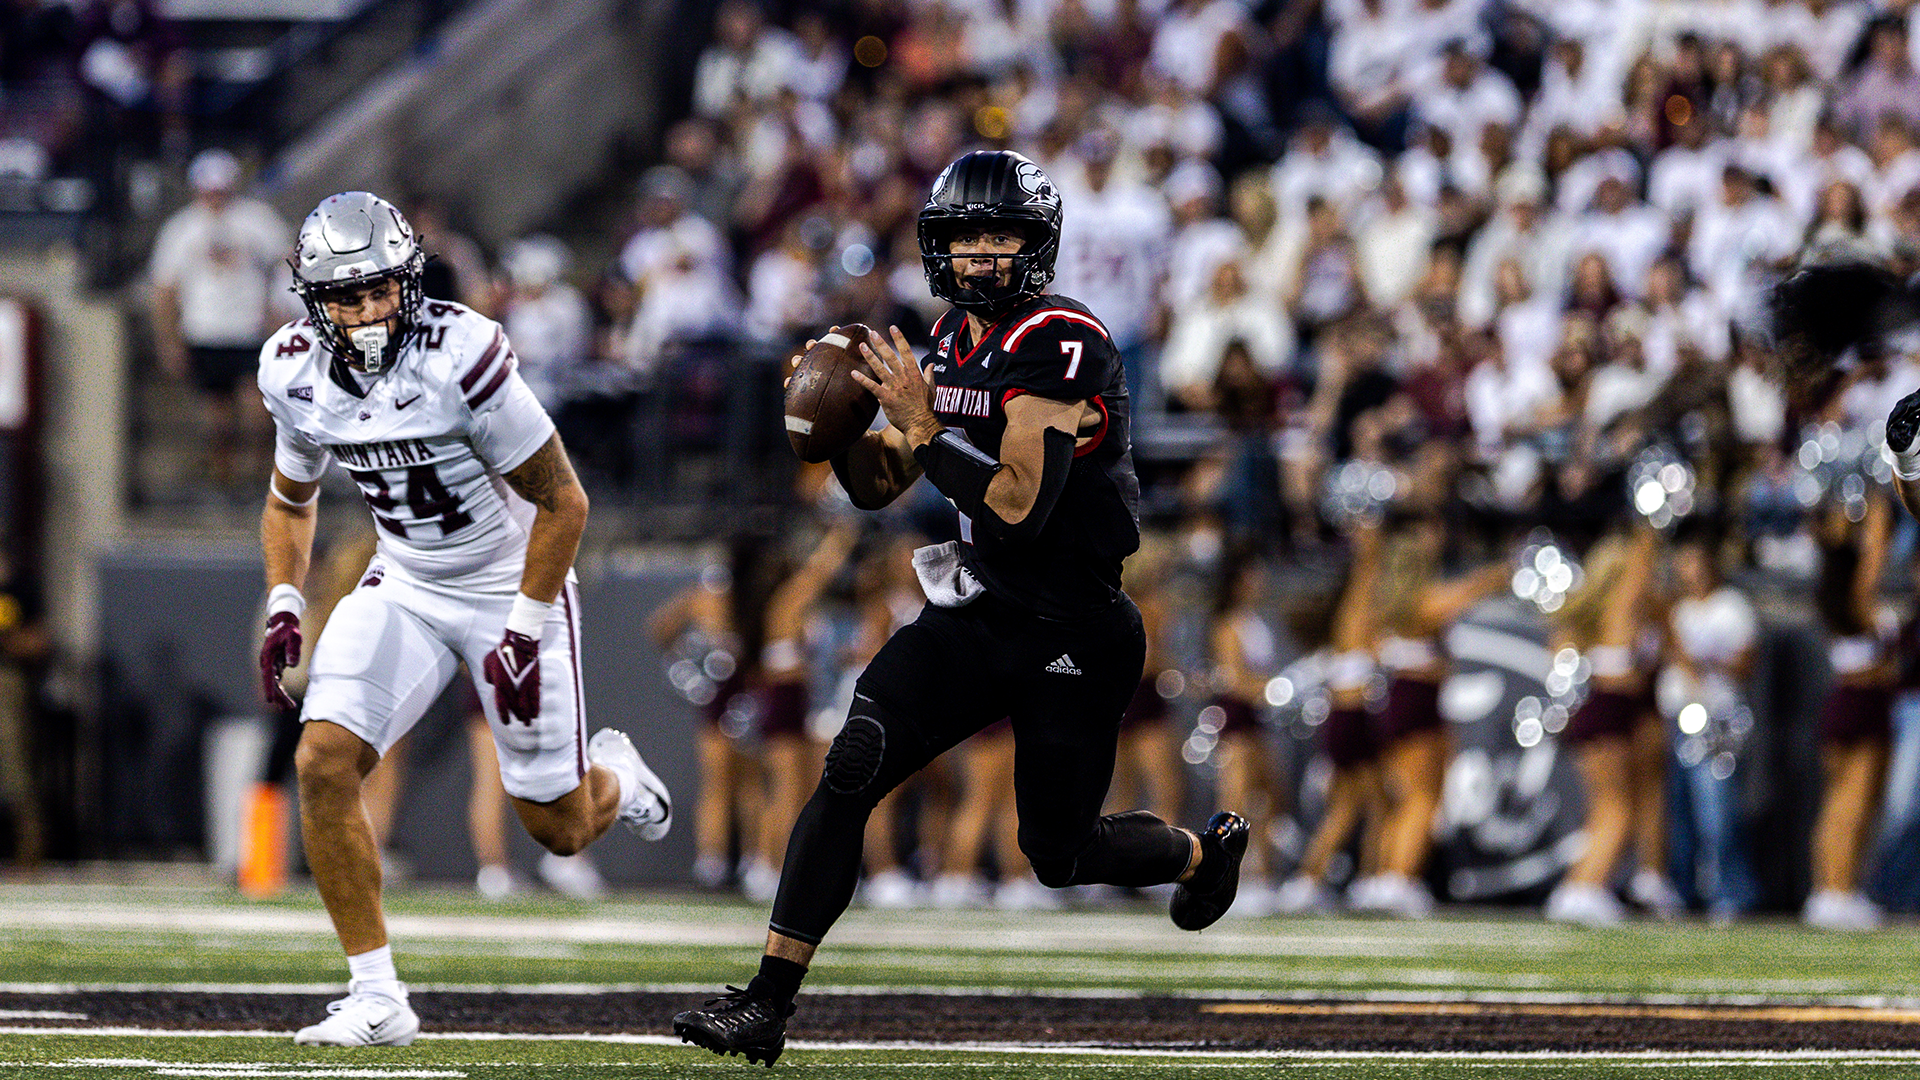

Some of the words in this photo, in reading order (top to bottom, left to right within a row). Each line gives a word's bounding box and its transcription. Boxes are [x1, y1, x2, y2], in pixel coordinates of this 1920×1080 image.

[1059, 340, 1083, 380] 7
[933, 385, 964, 413] THERN
[961, 387, 990, 418] UTAH
[347, 463, 476, 541] 24
[1045, 665, 1082, 675] adidas
